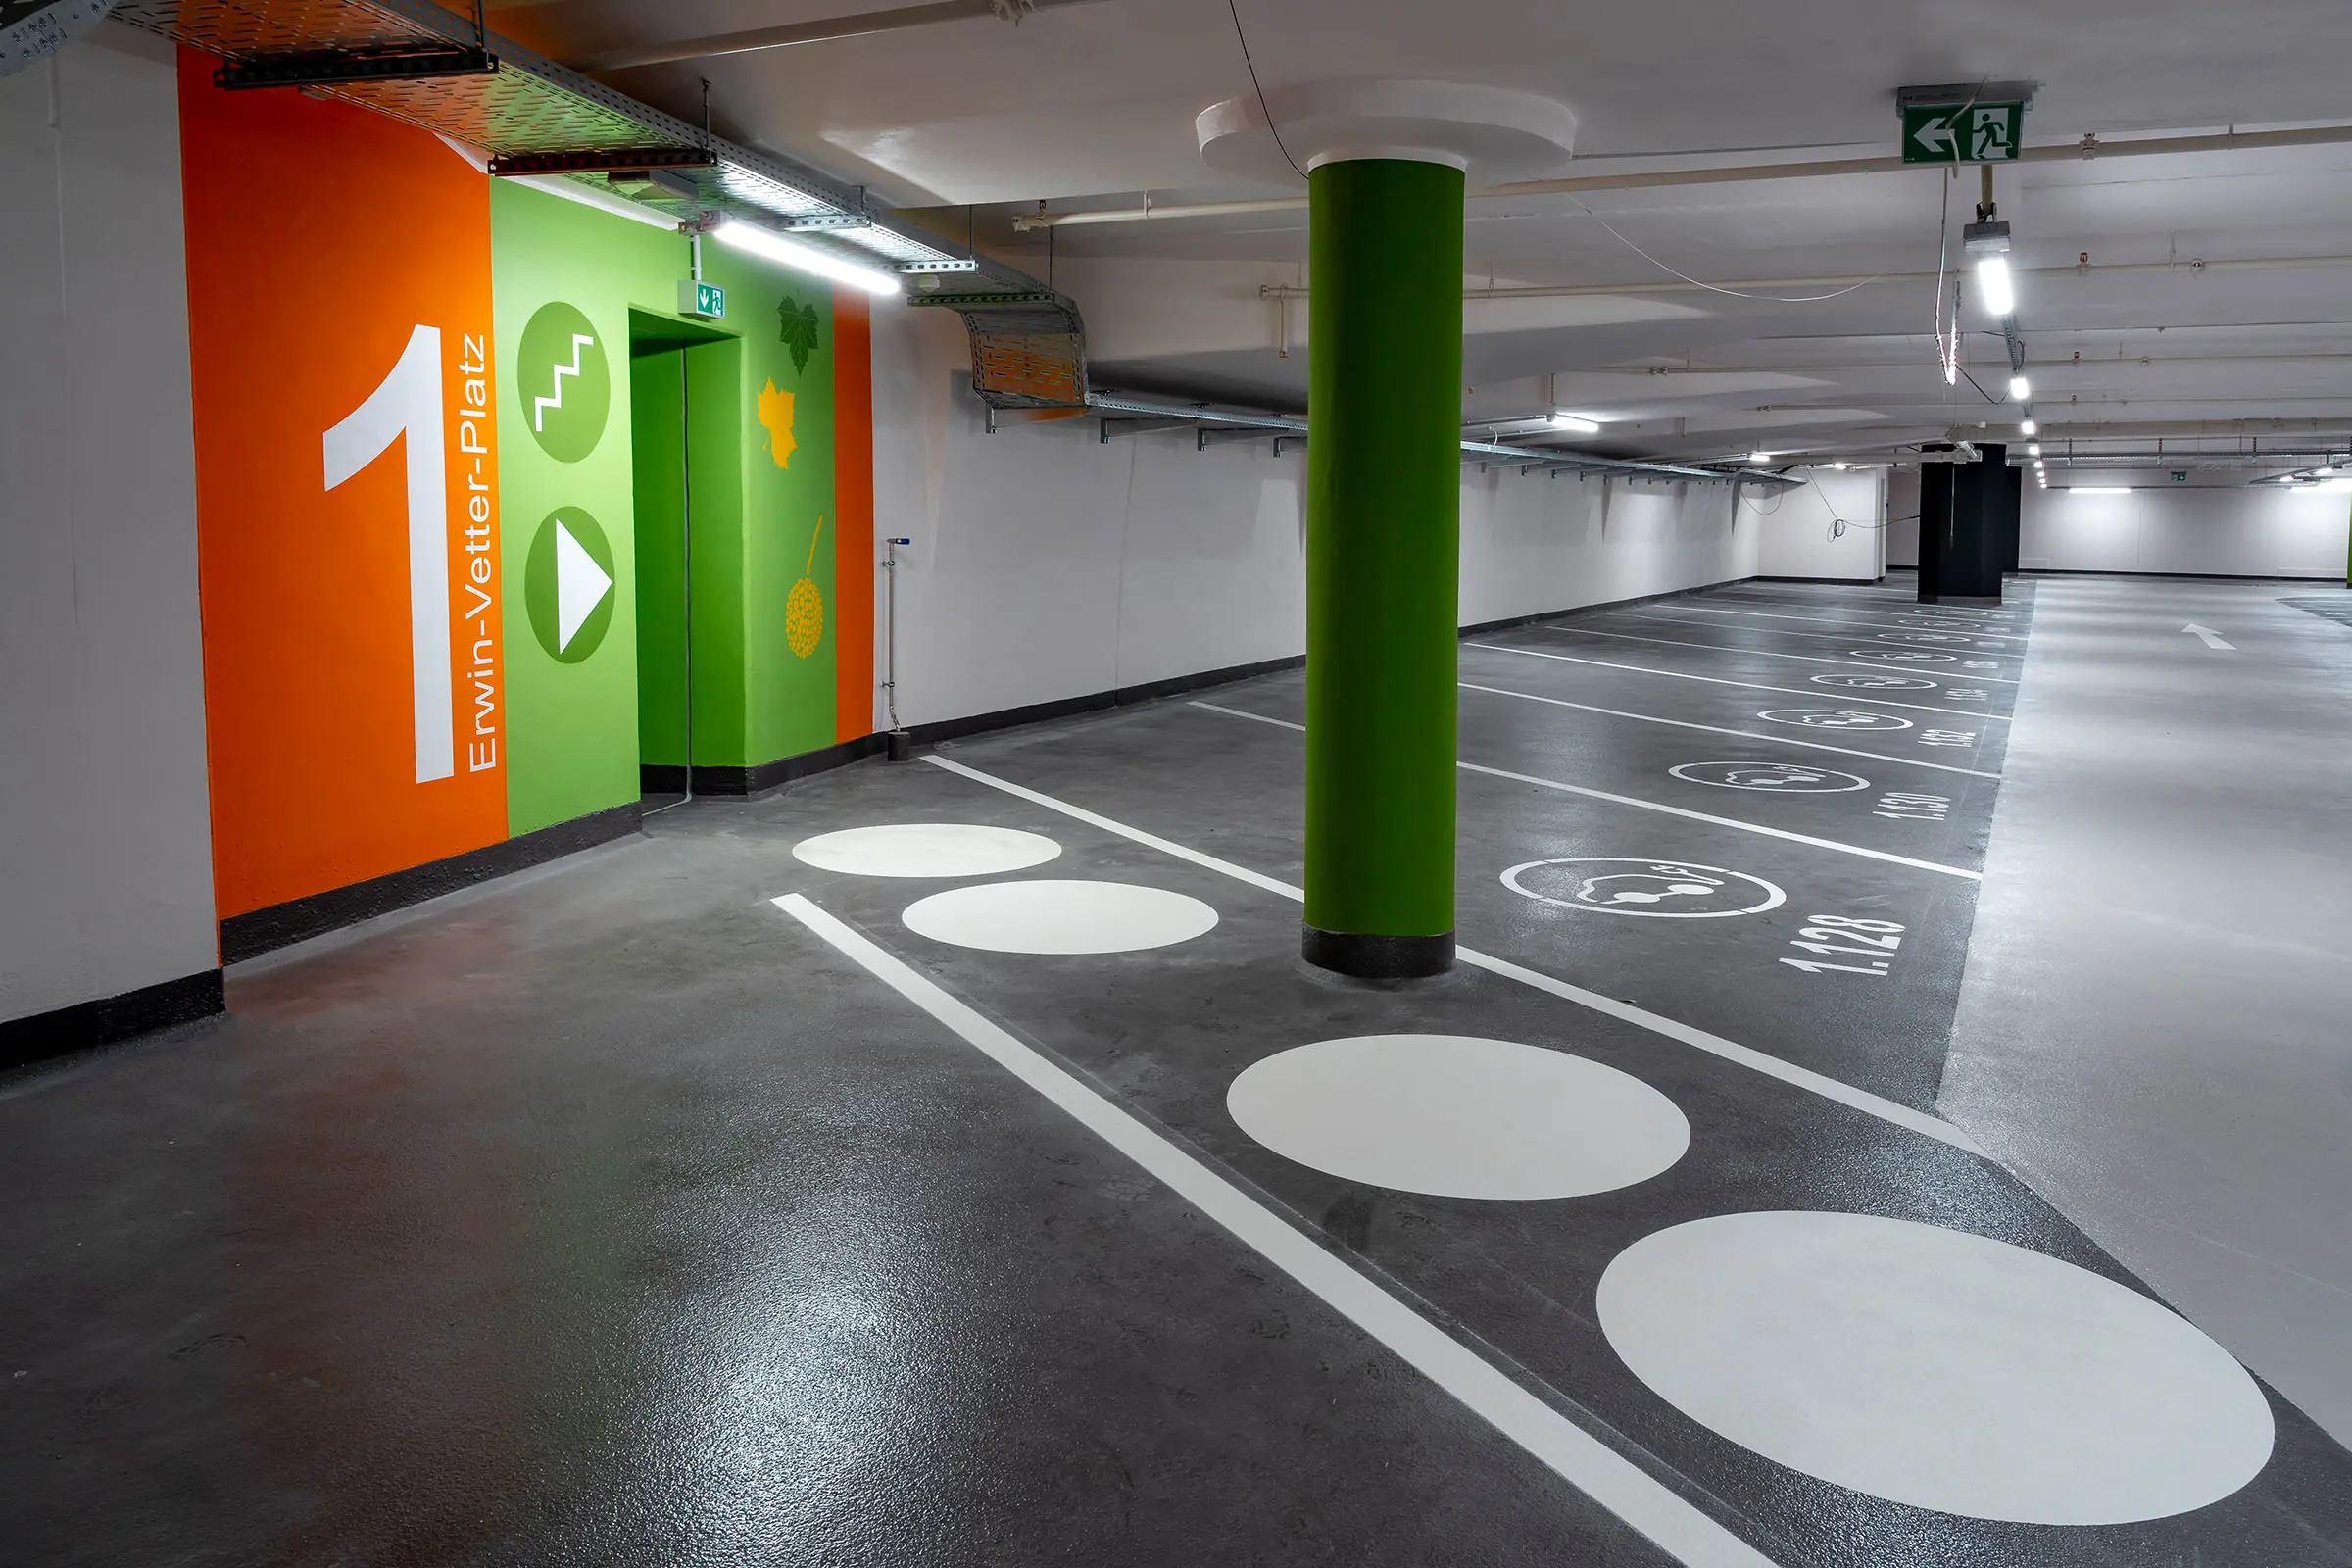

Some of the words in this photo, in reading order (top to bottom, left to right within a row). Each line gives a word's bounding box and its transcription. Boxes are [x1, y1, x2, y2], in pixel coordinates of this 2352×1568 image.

[323, 324, 455, 784] 1
[459, 333, 497, 773] Erwin-Vetter-Platz
[1917, 728, 1977, 748] 1.132
[1872, 792, 1952, 821] 1.130
[1779, 914, 1906, 976] 1.128
